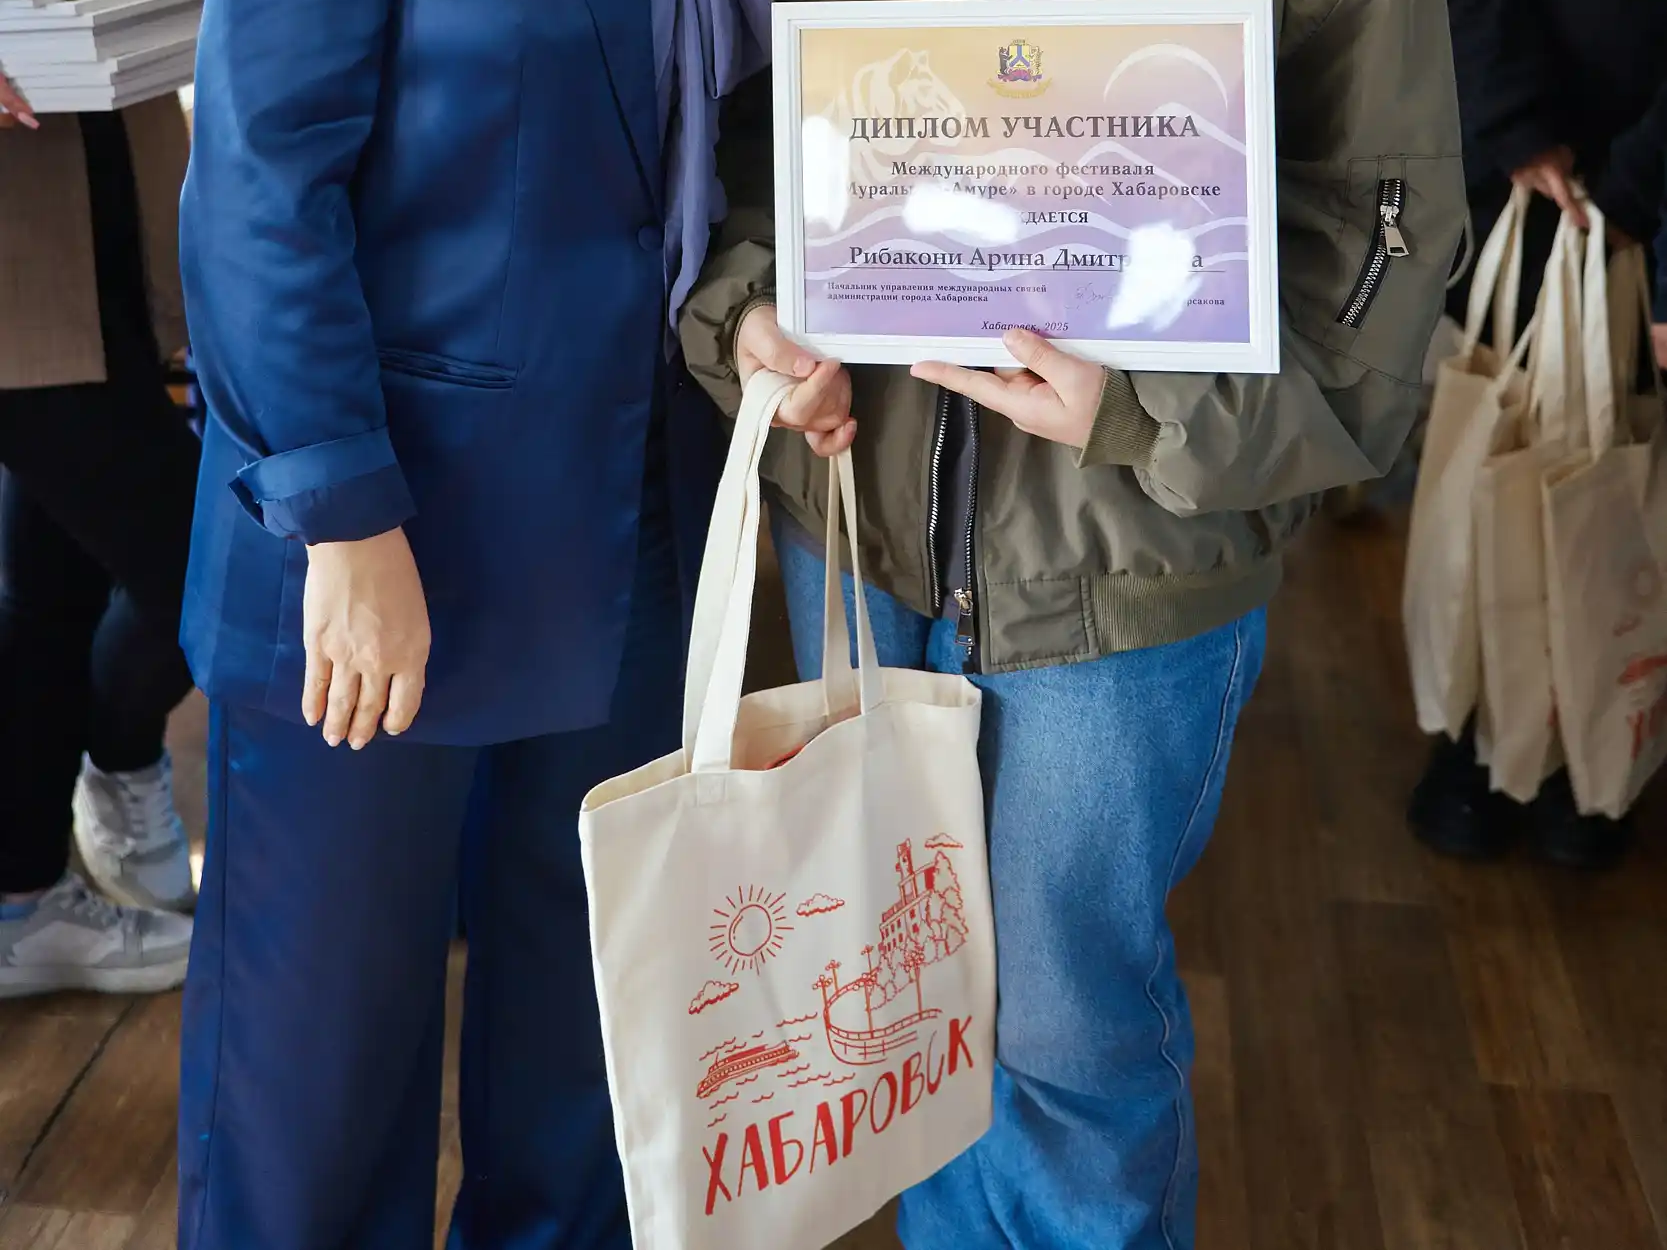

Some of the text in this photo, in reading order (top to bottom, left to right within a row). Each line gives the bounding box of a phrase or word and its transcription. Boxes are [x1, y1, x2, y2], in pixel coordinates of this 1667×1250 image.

[849, 115, 1201, 142] ДИПЛОМ УЧАСТНИКА
[891, 161, 1155, 179] Международного фестиваля
[1027, 186, 1036, 196] в
[1044, 185, 1104, 199] городе
[1111, 181, 1221, 199] Хабаровске
[849, 246, 1204, 272] Рибакони Арина Дмитра
[827, 282, 1047, 293] Начальник управления международных связей
[827, 293, 988, 303] администрации города Хабаровска
[1186, 297, 1225, 307] рсакова
[1044, 321, 1069, 332] 2025
[702, 1014, 974, 1216] ХАБАРОВСК
